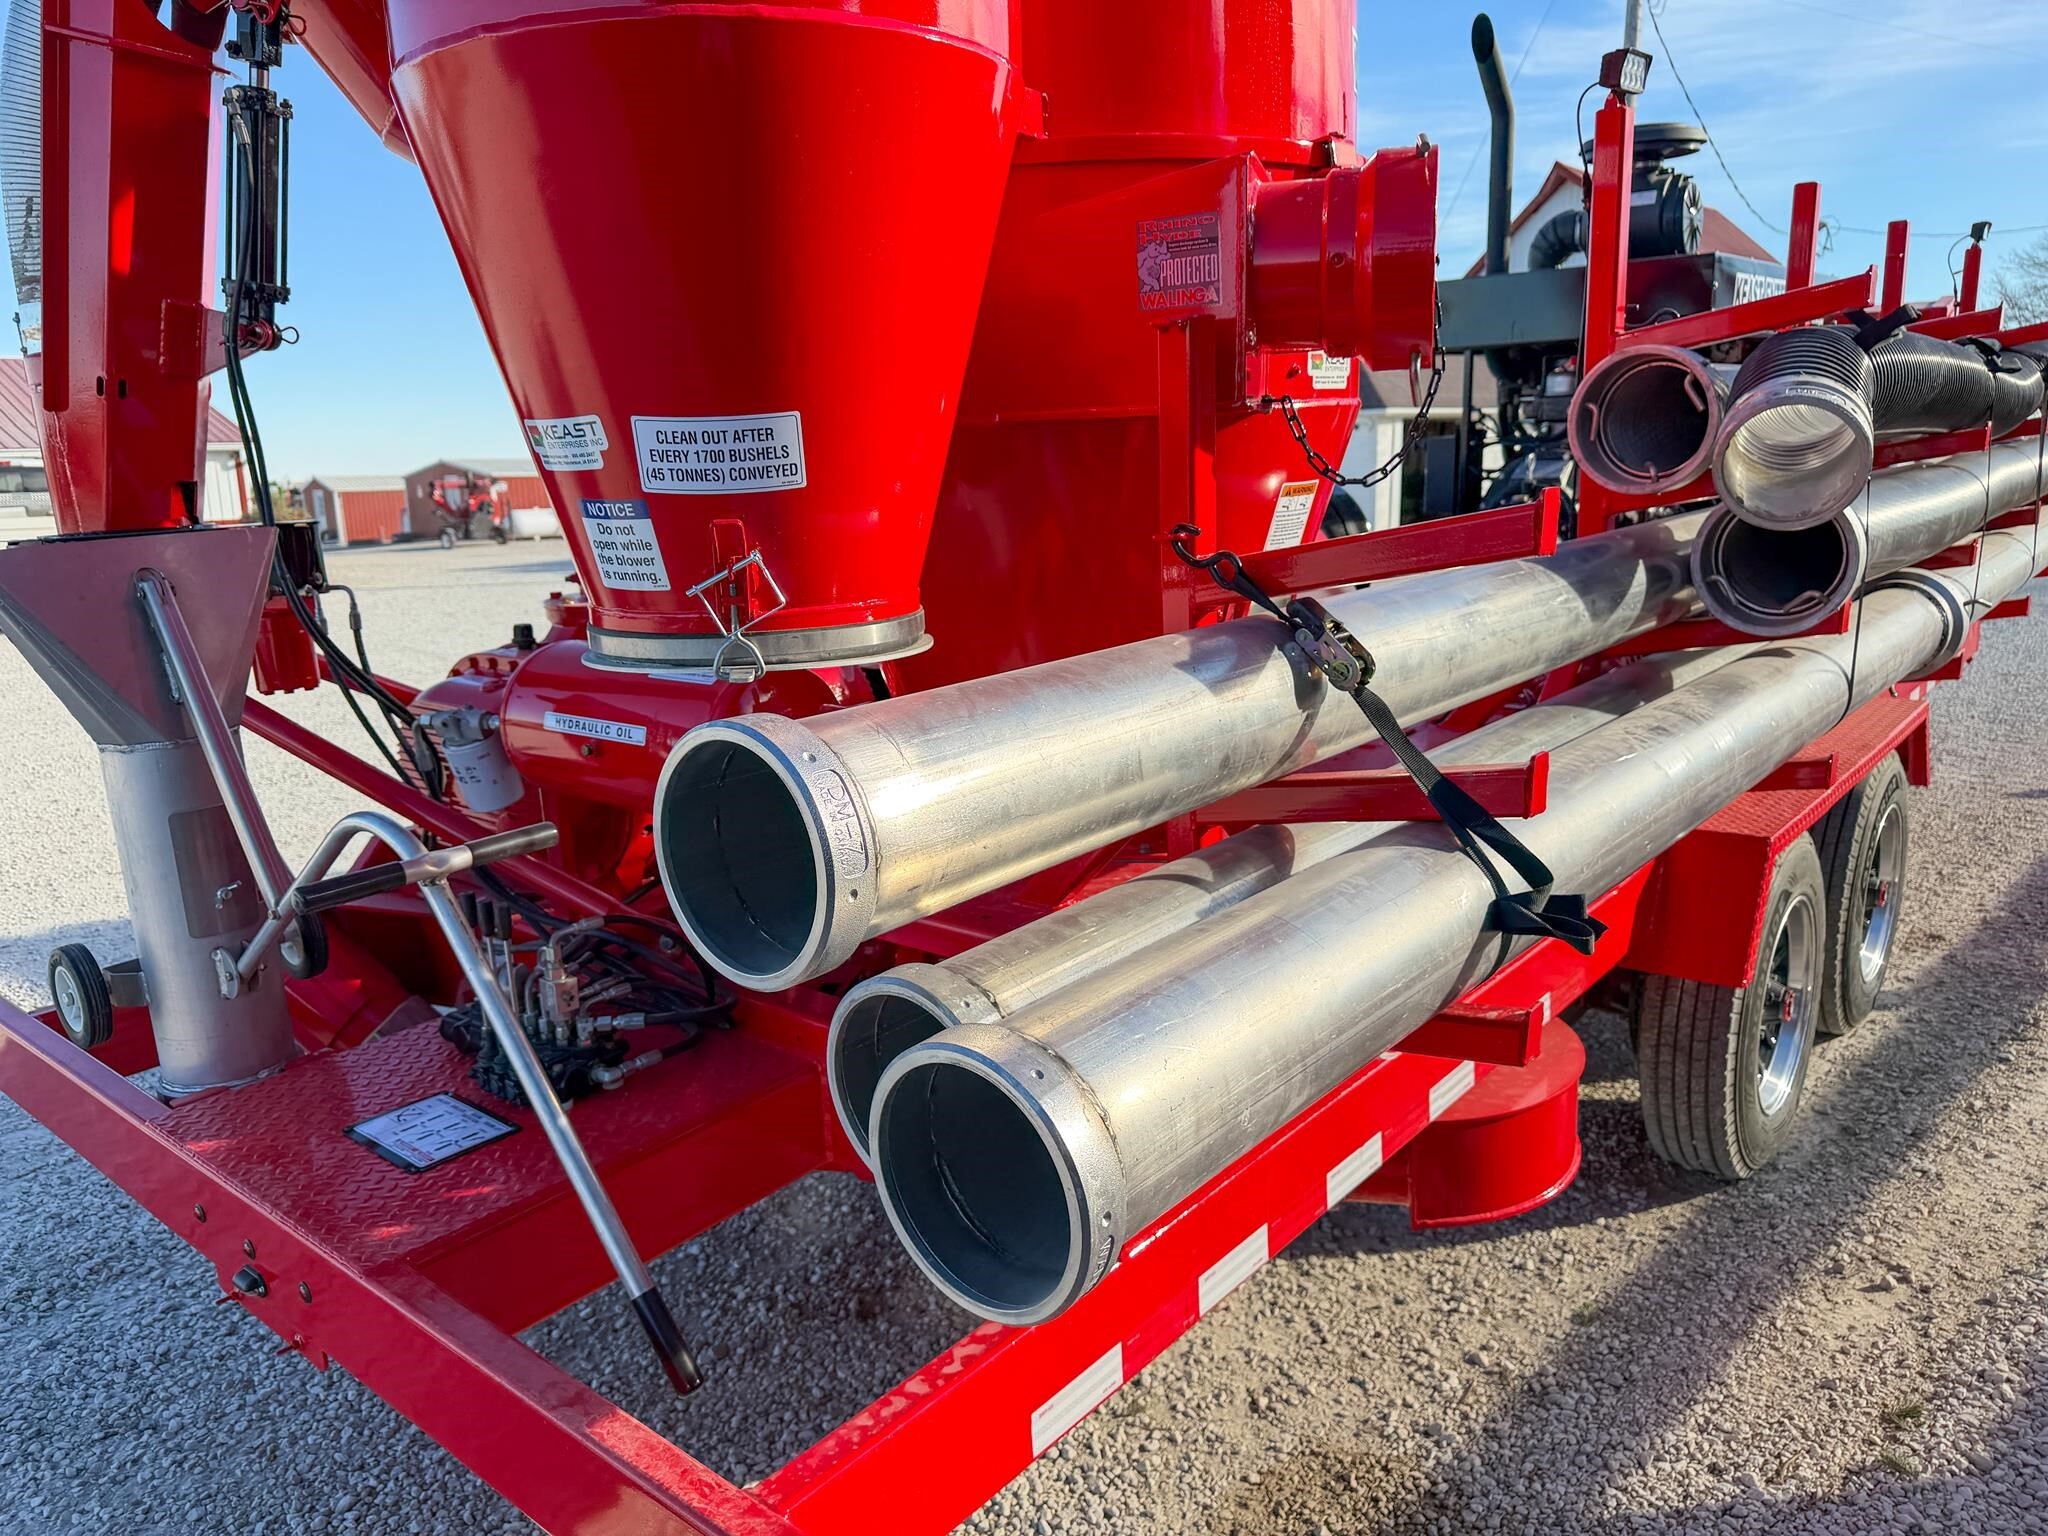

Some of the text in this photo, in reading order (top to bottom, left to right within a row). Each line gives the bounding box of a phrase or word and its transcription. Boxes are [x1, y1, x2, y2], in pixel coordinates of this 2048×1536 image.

[1139, 216, 1215, 232] RHINO
[1139, 229, 1202, 246] HYDE
[1160, 253, 1218, 287] PROTECTED
[1140, 285, 1219, 310] WALINGA
[541, 421, 597, 441] KEAST
[656, 427, 775, 445] CLEAN OUT AFTER
[547, 437, 604, 450] ENTERPRISES INC
[650, 444, 790, 464] EVERY 1700 BUSHELS
[645, 462, 799, 485] (45 TONNES) CONVEYED
[586, 502, 635, 517] NOTICE
[597, 522, 636, 536] Do not
[593, 539, 653, 552] open while
[598, 553, 656, 567] the blower
[601, 567, 662, 585] is running.
[555, 718, 633, 739] HYDRAULIC OIL
